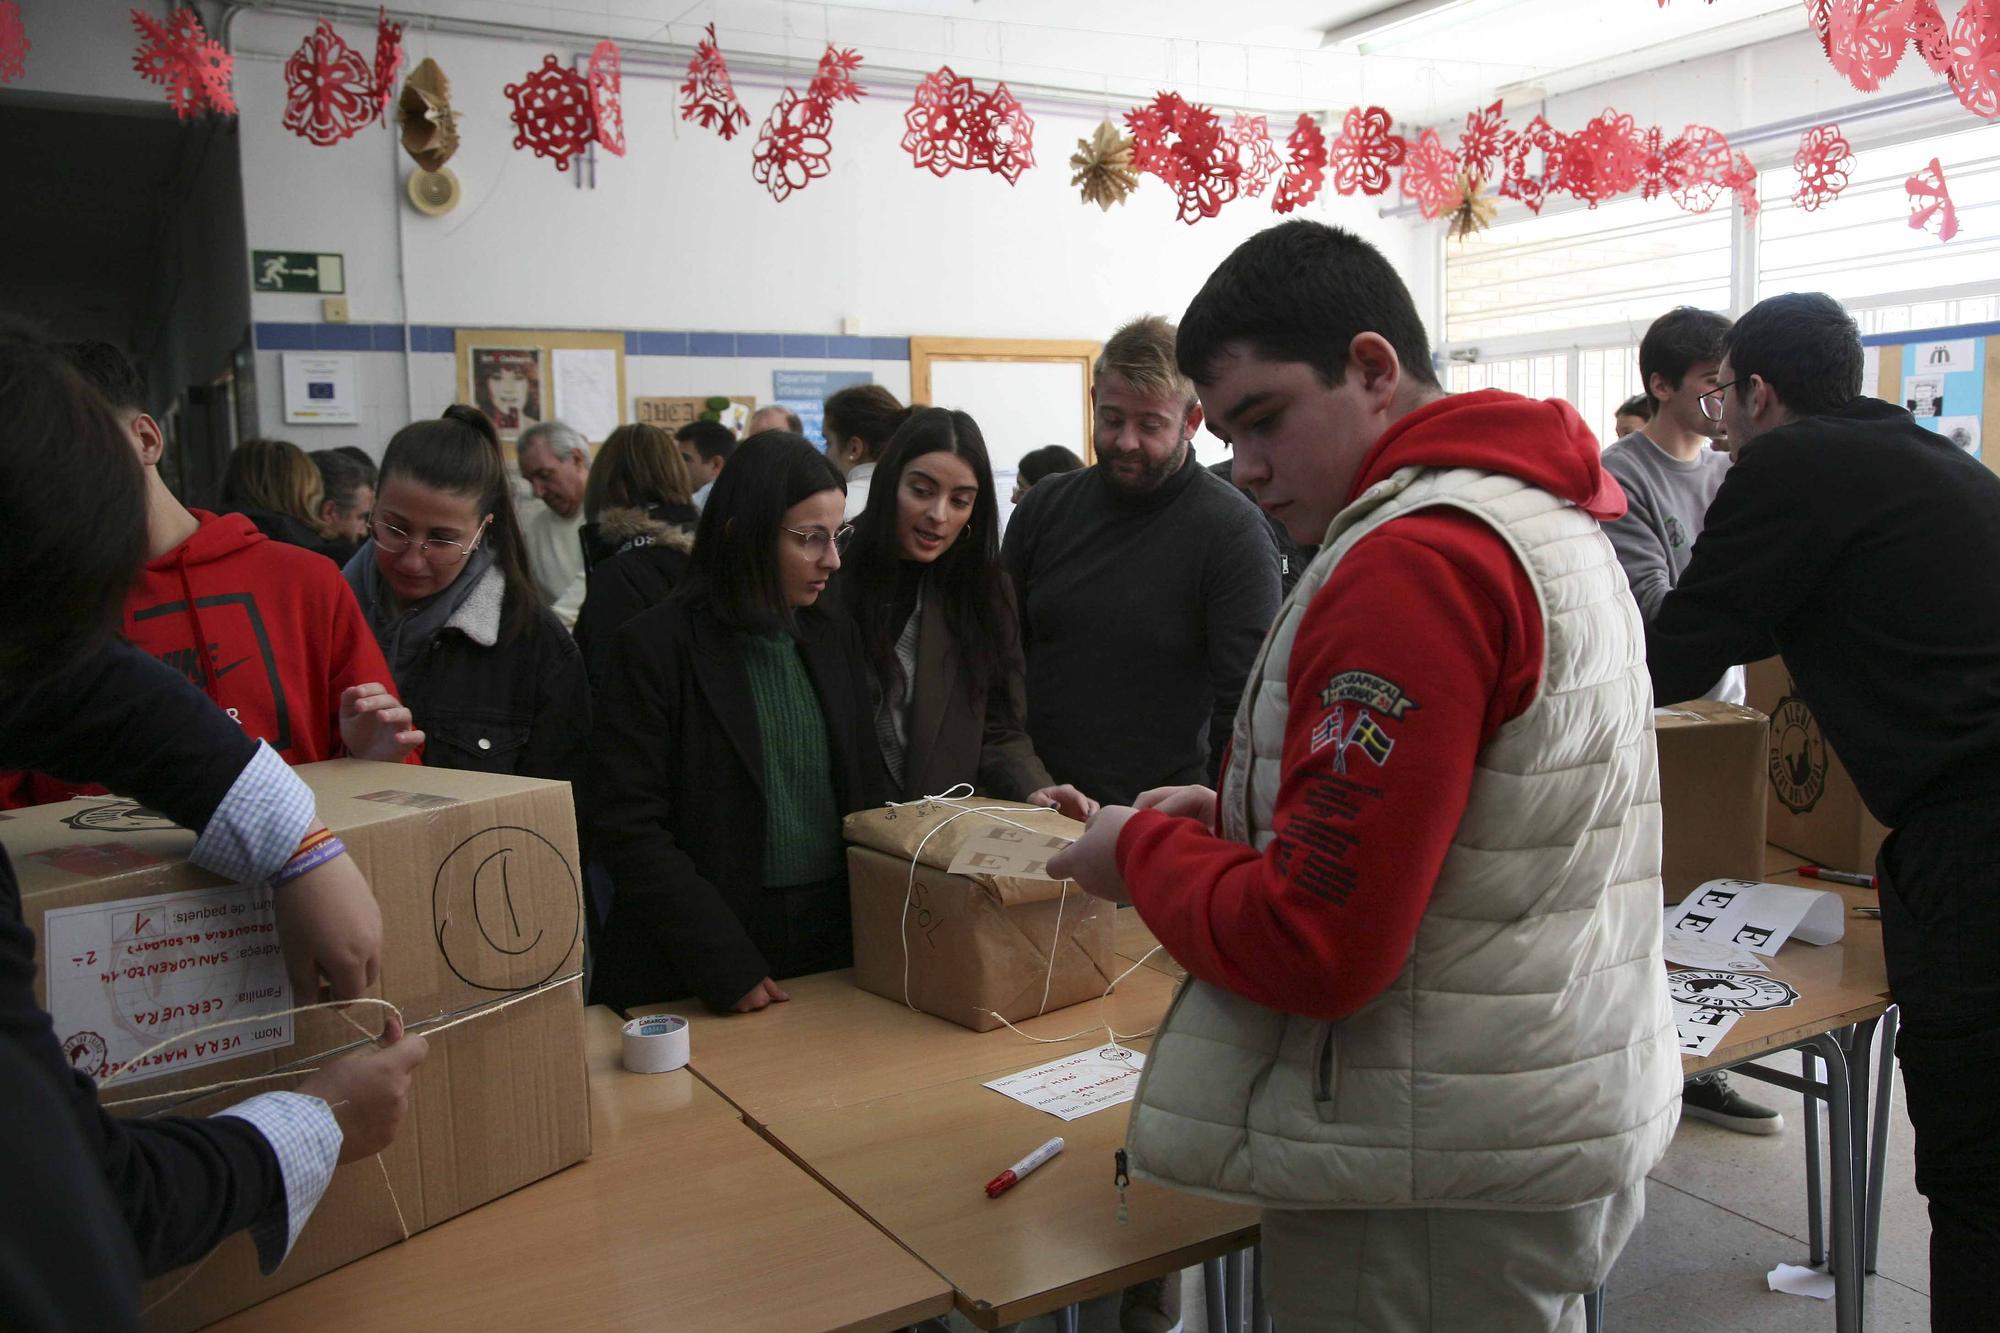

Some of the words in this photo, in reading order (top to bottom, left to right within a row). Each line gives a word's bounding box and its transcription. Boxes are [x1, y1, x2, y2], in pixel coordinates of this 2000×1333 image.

[172, 904, 227, 925] paquets:
[230, 903, 245, 916] de
[134, 913, 151, 935] 1
[1732, 922, 1776, 947] E
[1685, 995, 1752, 1006] ALCOI
[251, 1027, 282, 1041] Nom:
[194, 1035, 241, 1057] VERA
